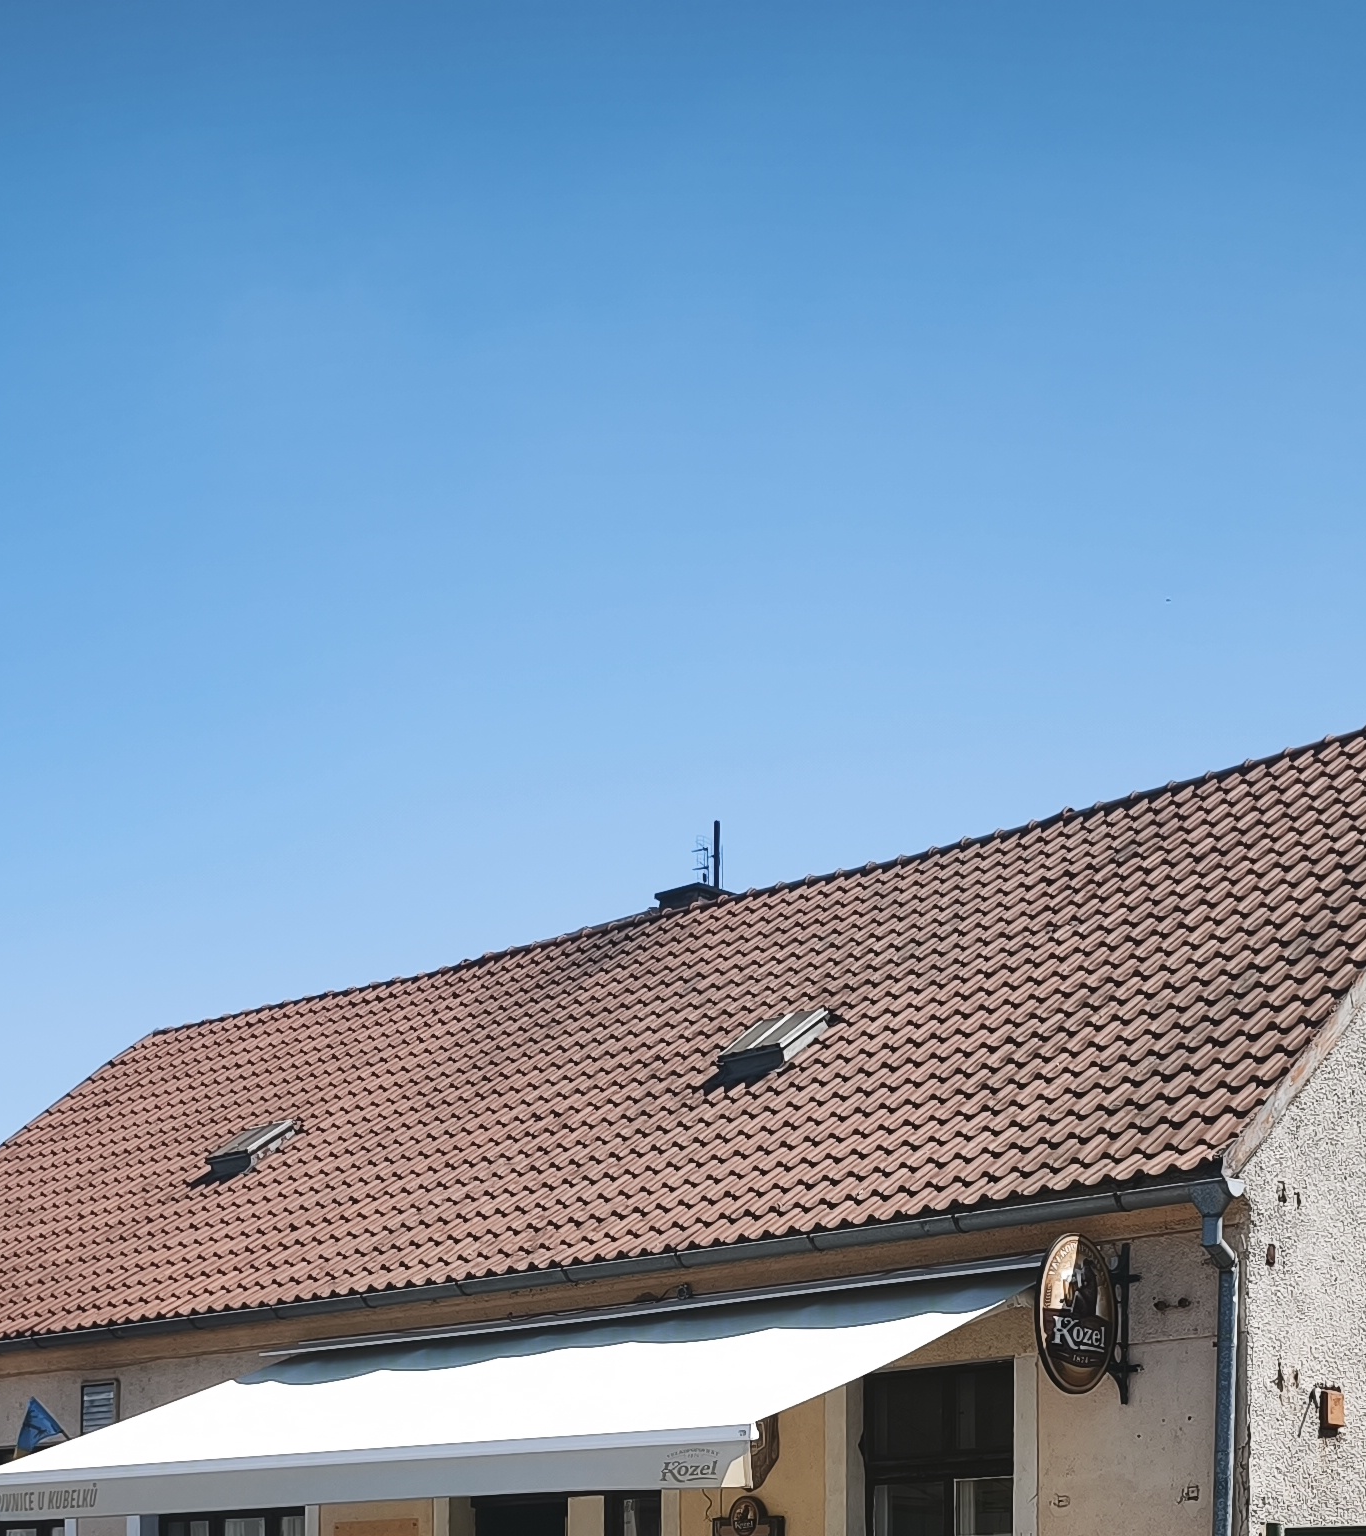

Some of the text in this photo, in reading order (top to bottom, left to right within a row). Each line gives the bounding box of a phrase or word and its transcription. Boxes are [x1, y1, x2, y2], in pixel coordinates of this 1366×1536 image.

[1051, 1315, 1105, 1350] Kozel
[660, 1460, 718, 1483] Kozel
[38, 1491, 46, 1511] U
[47, 1482, 98, 1510] KUBELKŮ
